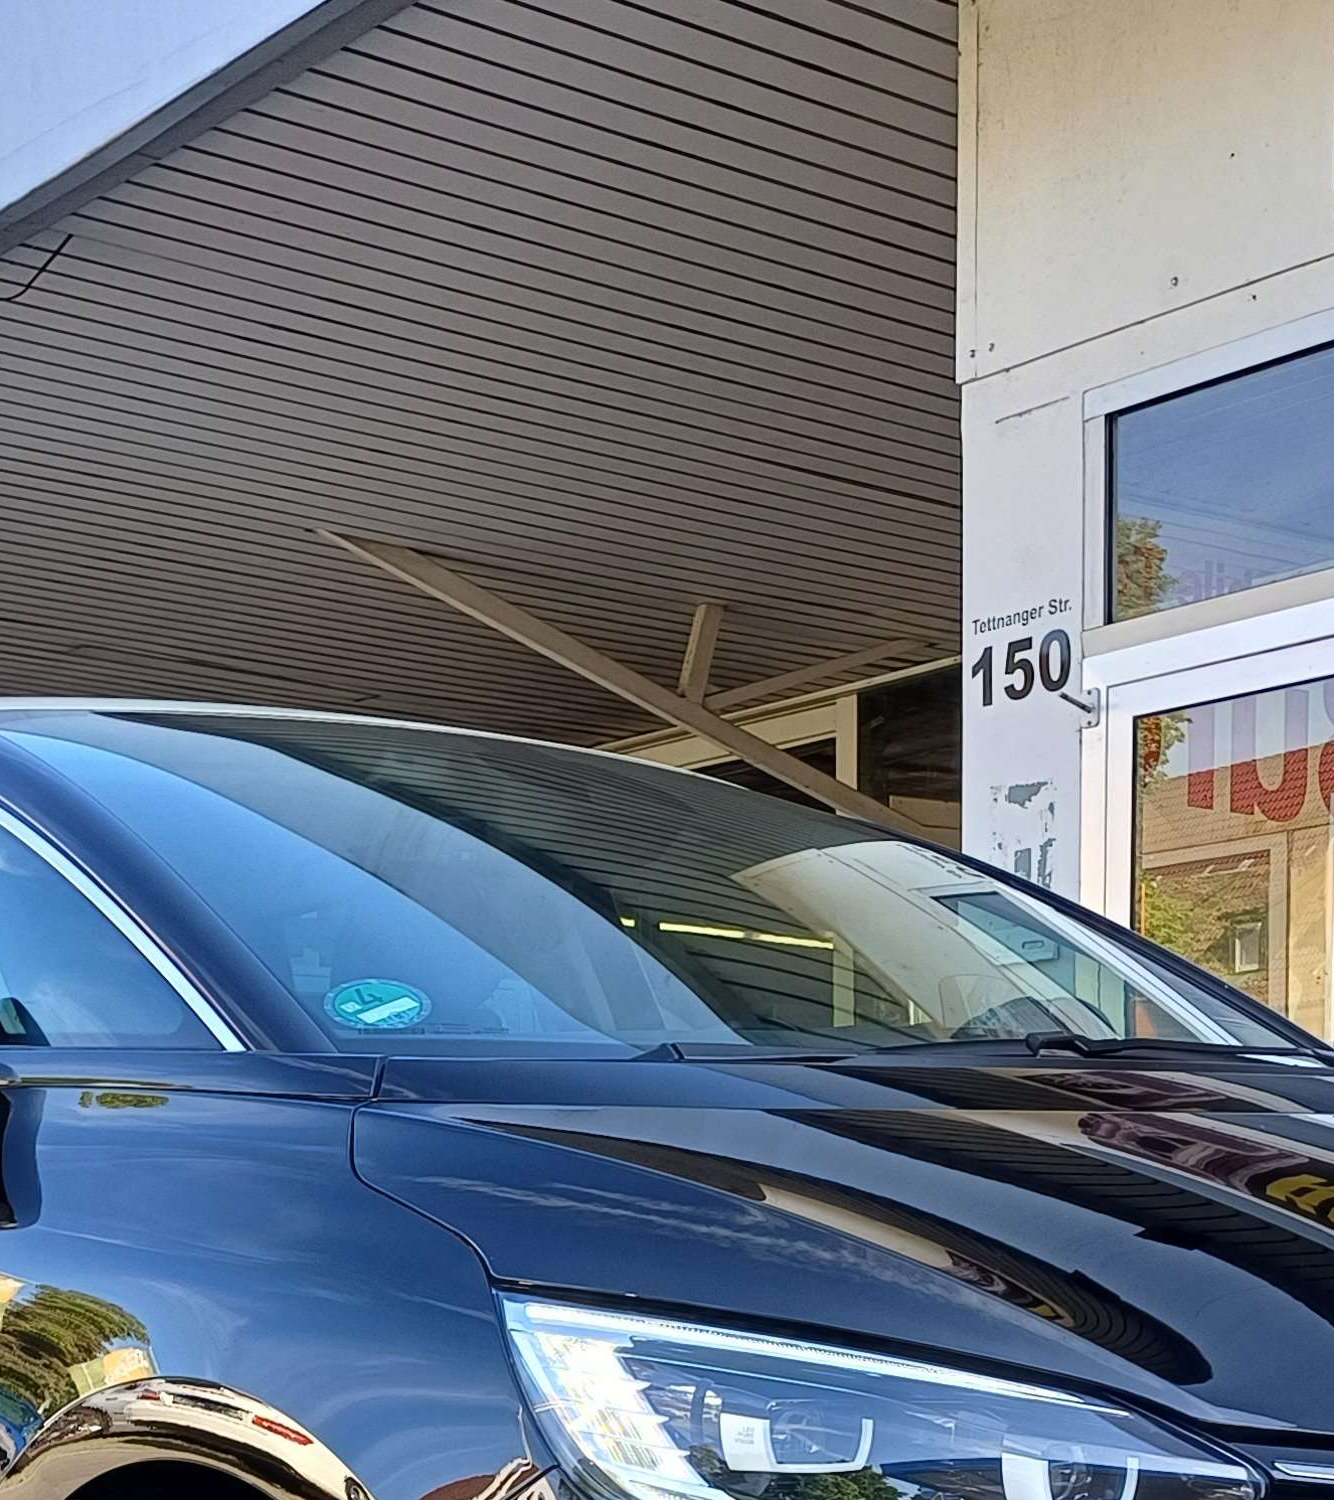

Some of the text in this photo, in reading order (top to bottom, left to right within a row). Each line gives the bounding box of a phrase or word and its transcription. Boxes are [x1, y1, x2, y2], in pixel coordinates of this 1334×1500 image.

[972, 598, 1073, 635] Tettnanger Str.
[971, 629, 1072, 707] 150
